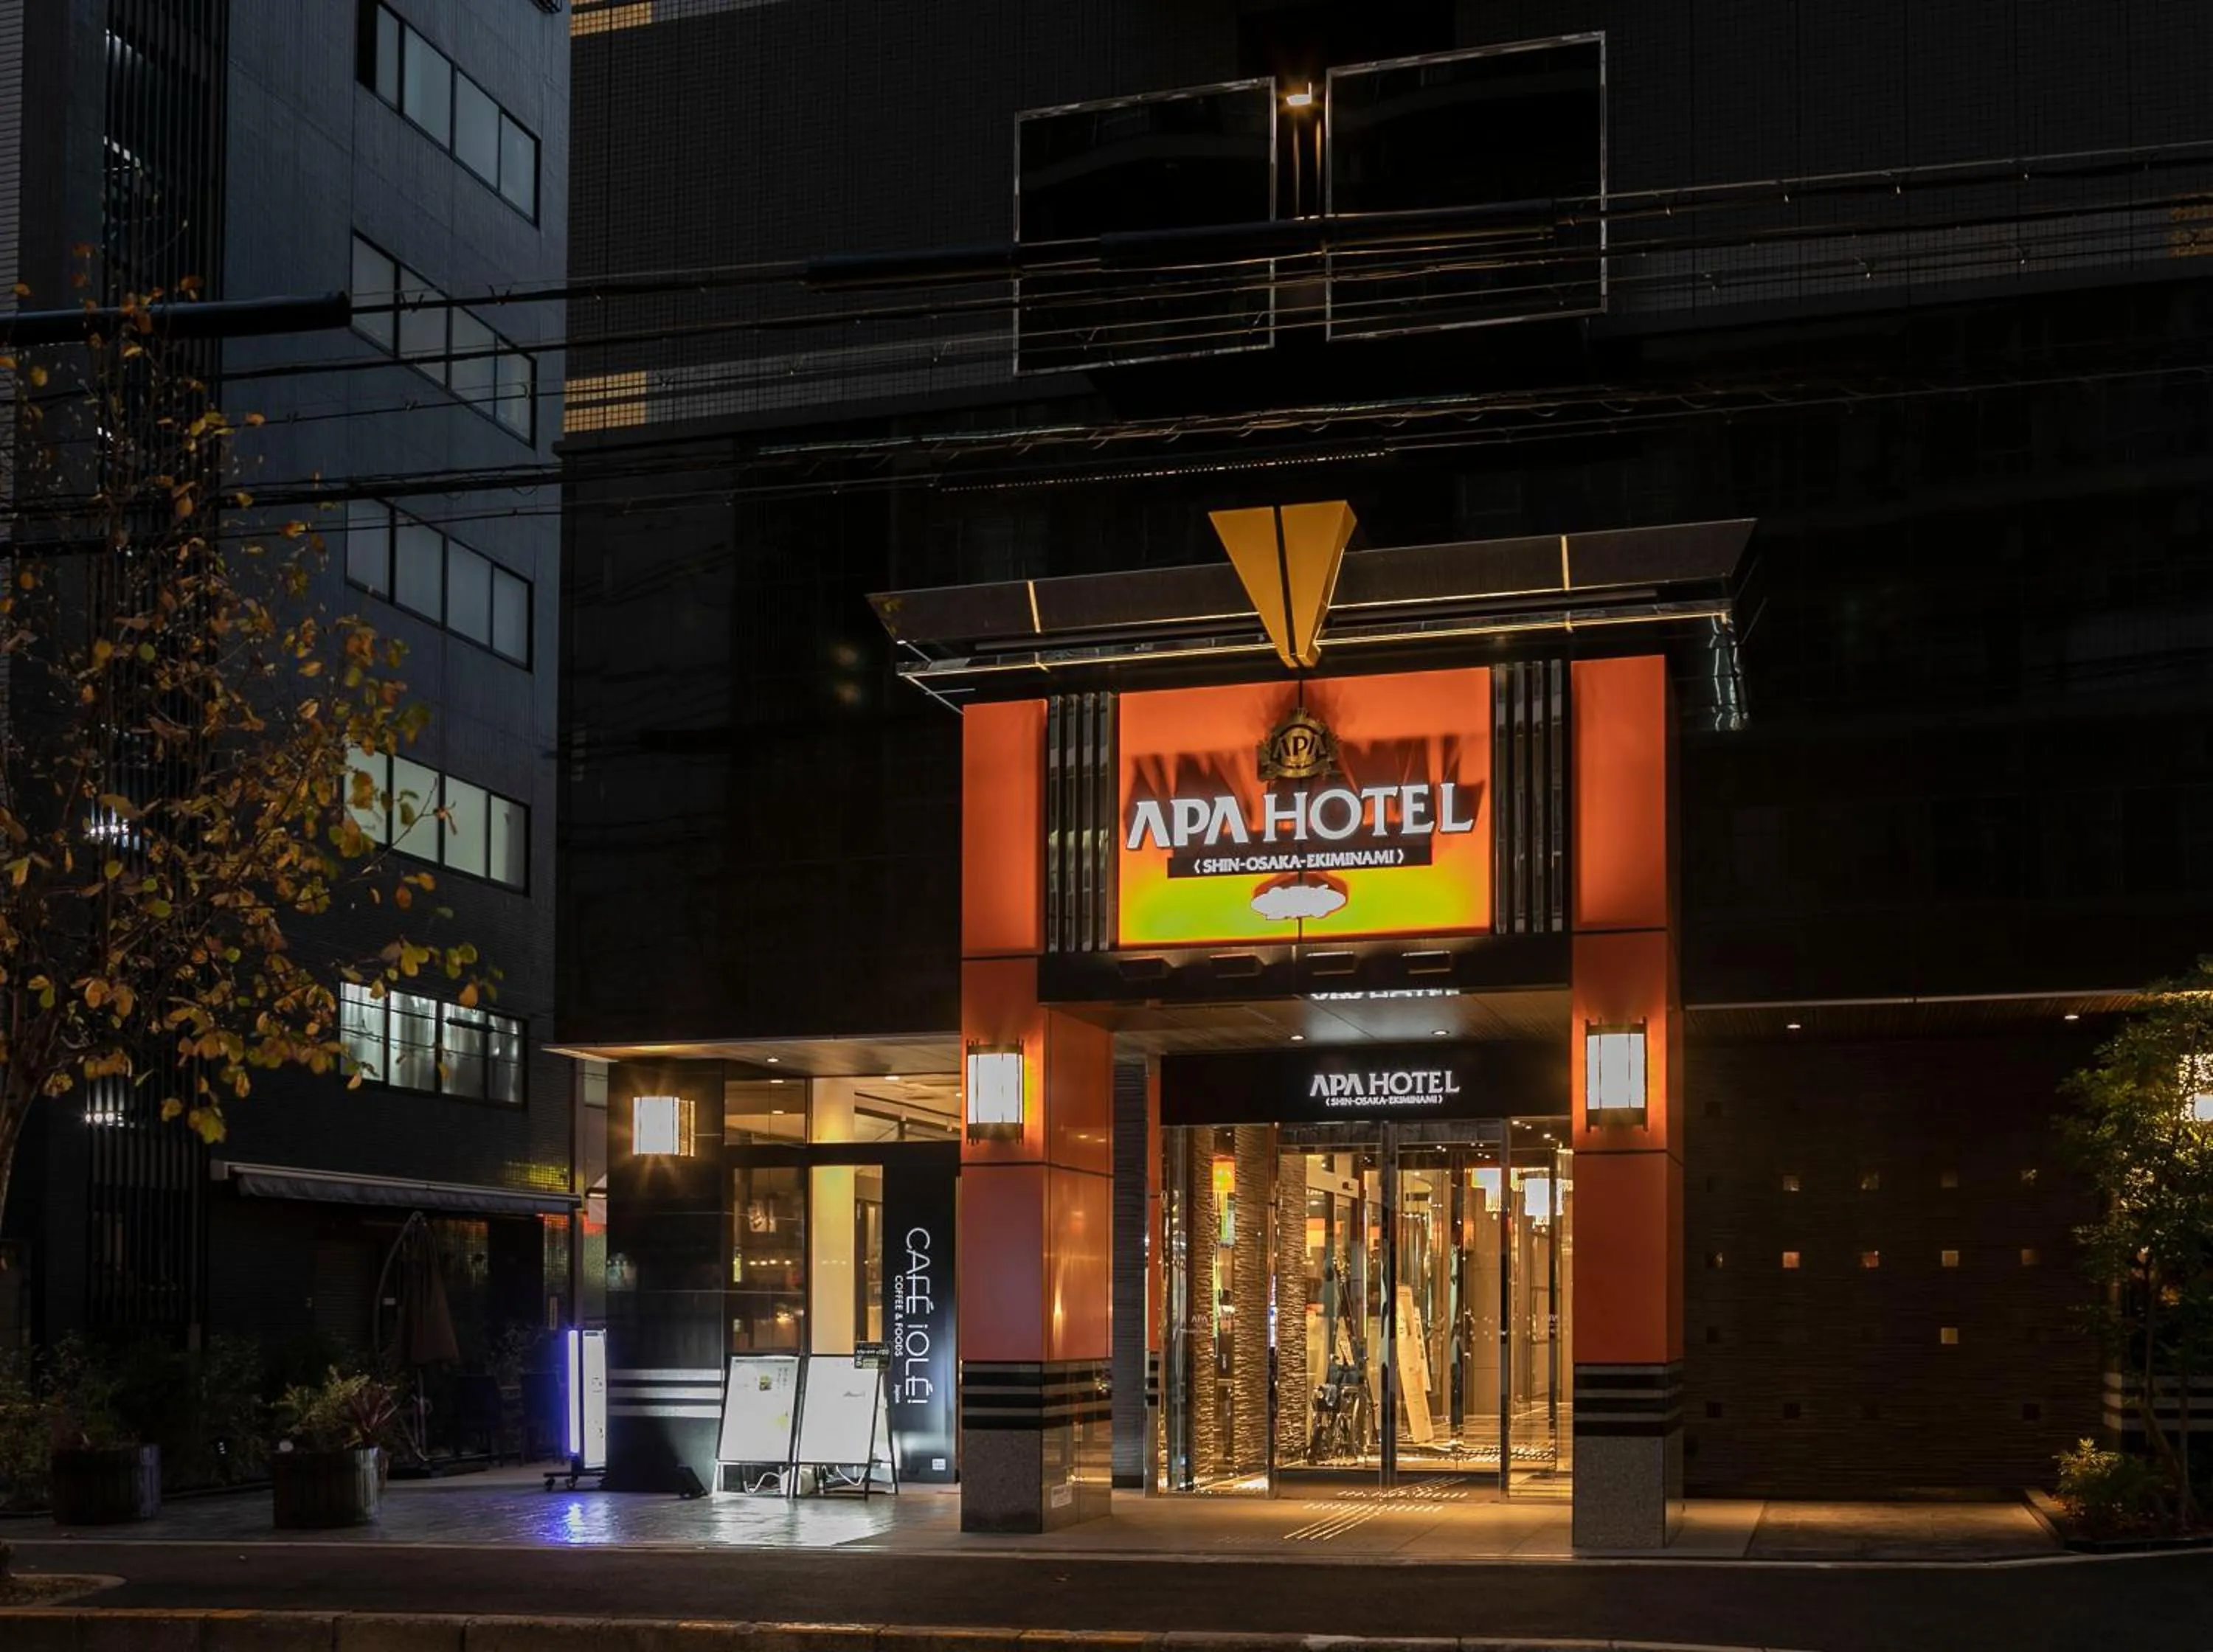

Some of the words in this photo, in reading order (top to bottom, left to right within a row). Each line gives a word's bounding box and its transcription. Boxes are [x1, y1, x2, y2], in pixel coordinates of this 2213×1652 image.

[1126, 796, 1248, 850] APA
[1263, 782, 1474, 844] HOTEL
[1310, 1074, 1364, 1097] APA
[1369, 1071, 1460, 1095] HOTEL
[906, 1227, 935, 1315] CAFÉ
[895, 1274, 903, 1311] COFFEE
[895, 1313, 903, 1321] &
[895, 1323, 903, 1357] FOODS
